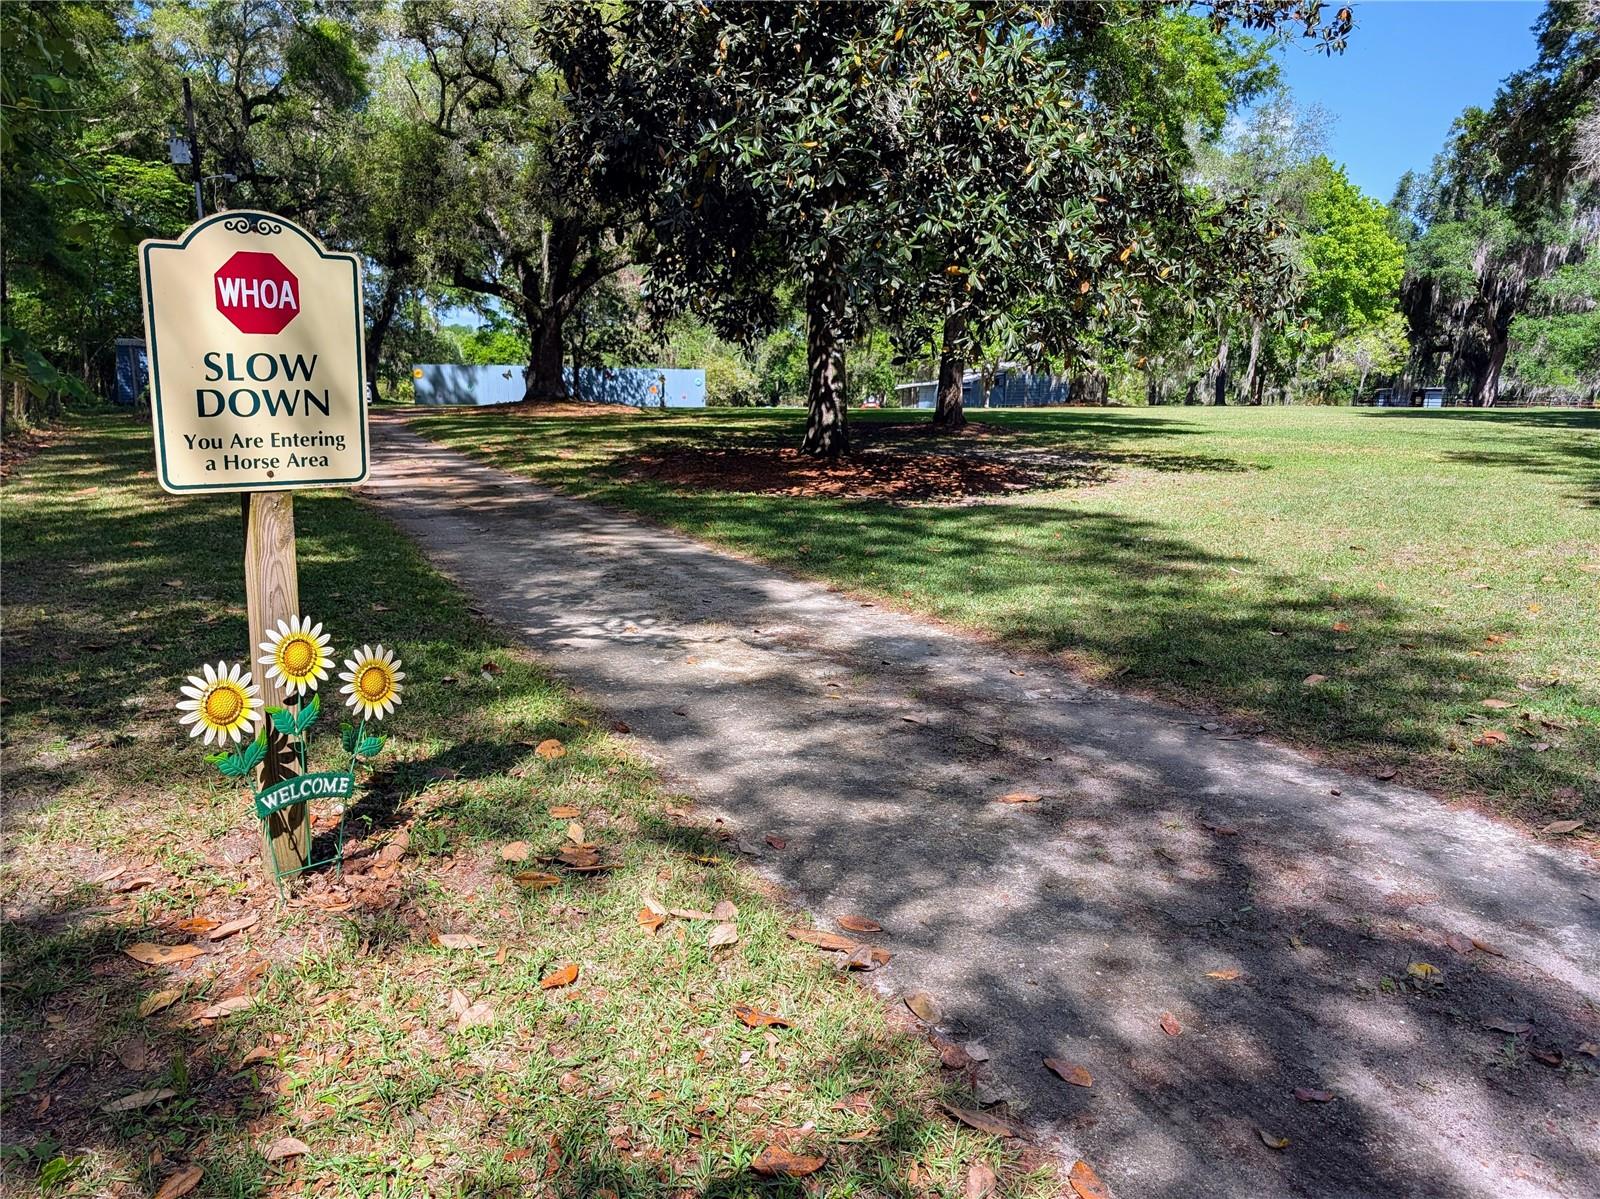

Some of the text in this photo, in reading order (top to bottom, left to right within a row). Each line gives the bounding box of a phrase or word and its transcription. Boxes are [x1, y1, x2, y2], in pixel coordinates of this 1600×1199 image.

[217, 277, 297, 310] WHOA
[203, 352, 318, 382] SLOW
[196, 388, 330, 418] DOWN
[183, 430, 346, 451] You Are Entering
[205, 452, 329, 471] a Horse Area
[260, 777, 350, 809] WELCOME
